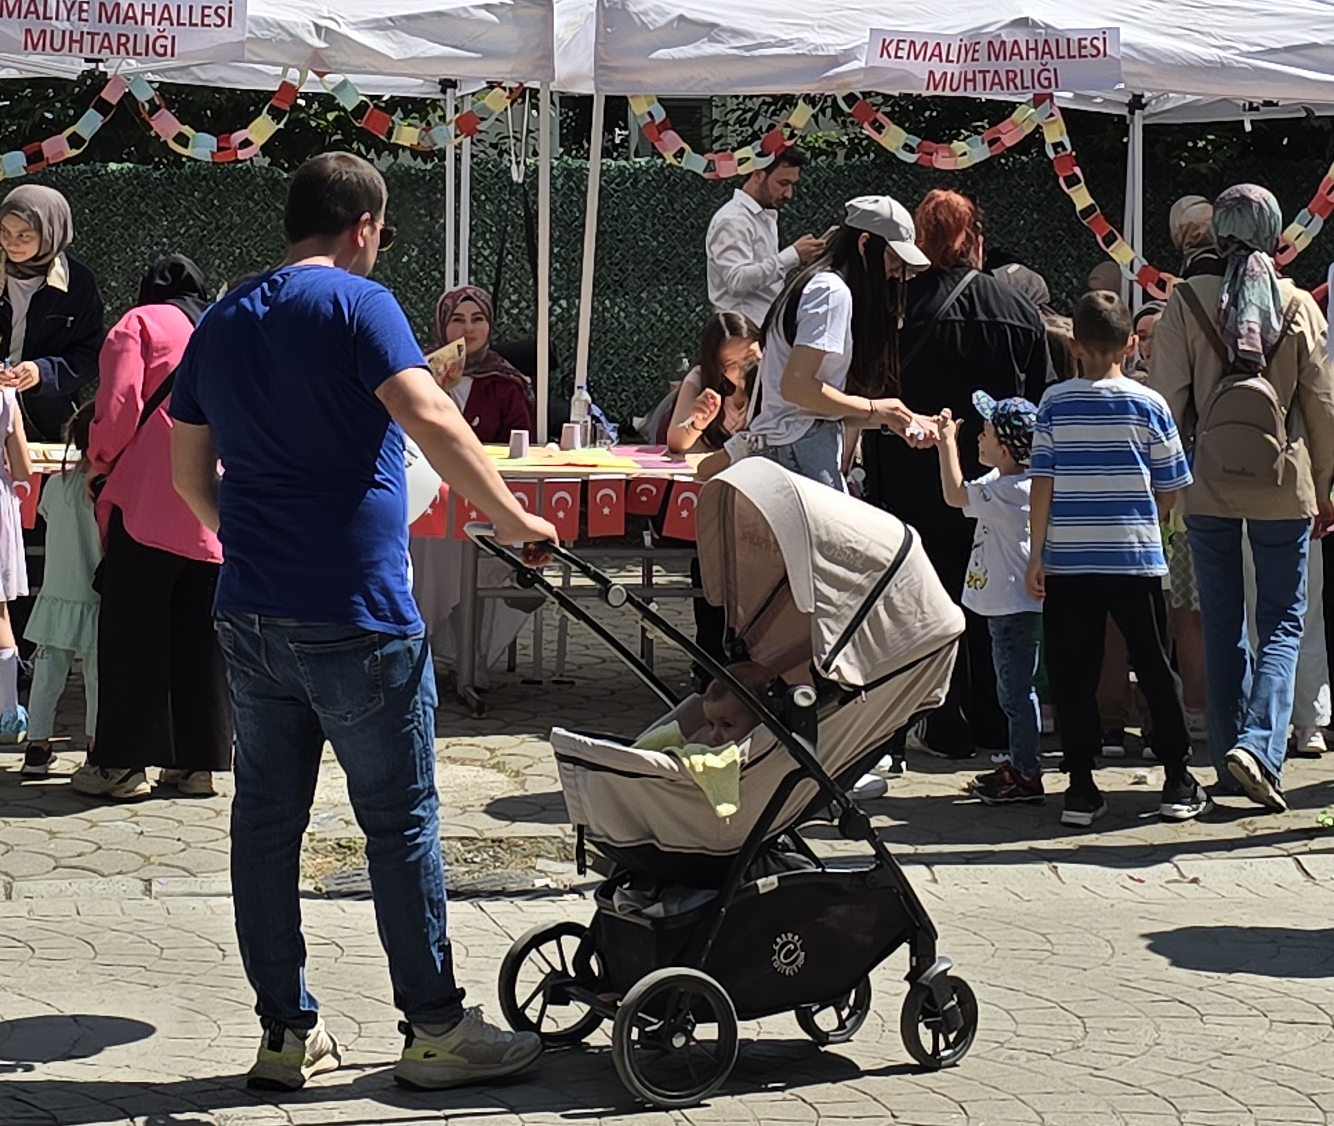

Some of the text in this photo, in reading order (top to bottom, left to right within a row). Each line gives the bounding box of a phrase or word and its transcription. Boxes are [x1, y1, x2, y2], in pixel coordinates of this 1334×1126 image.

[97, 0, 234, 28] MAHALLESİ
[23, 27, 176, 58] MUHTARLIĞI
[879, 31, 1108, 64] KEMALİYE MAHALLESİ
[925, 62, 1059, 92] MUHTARLIĞI
